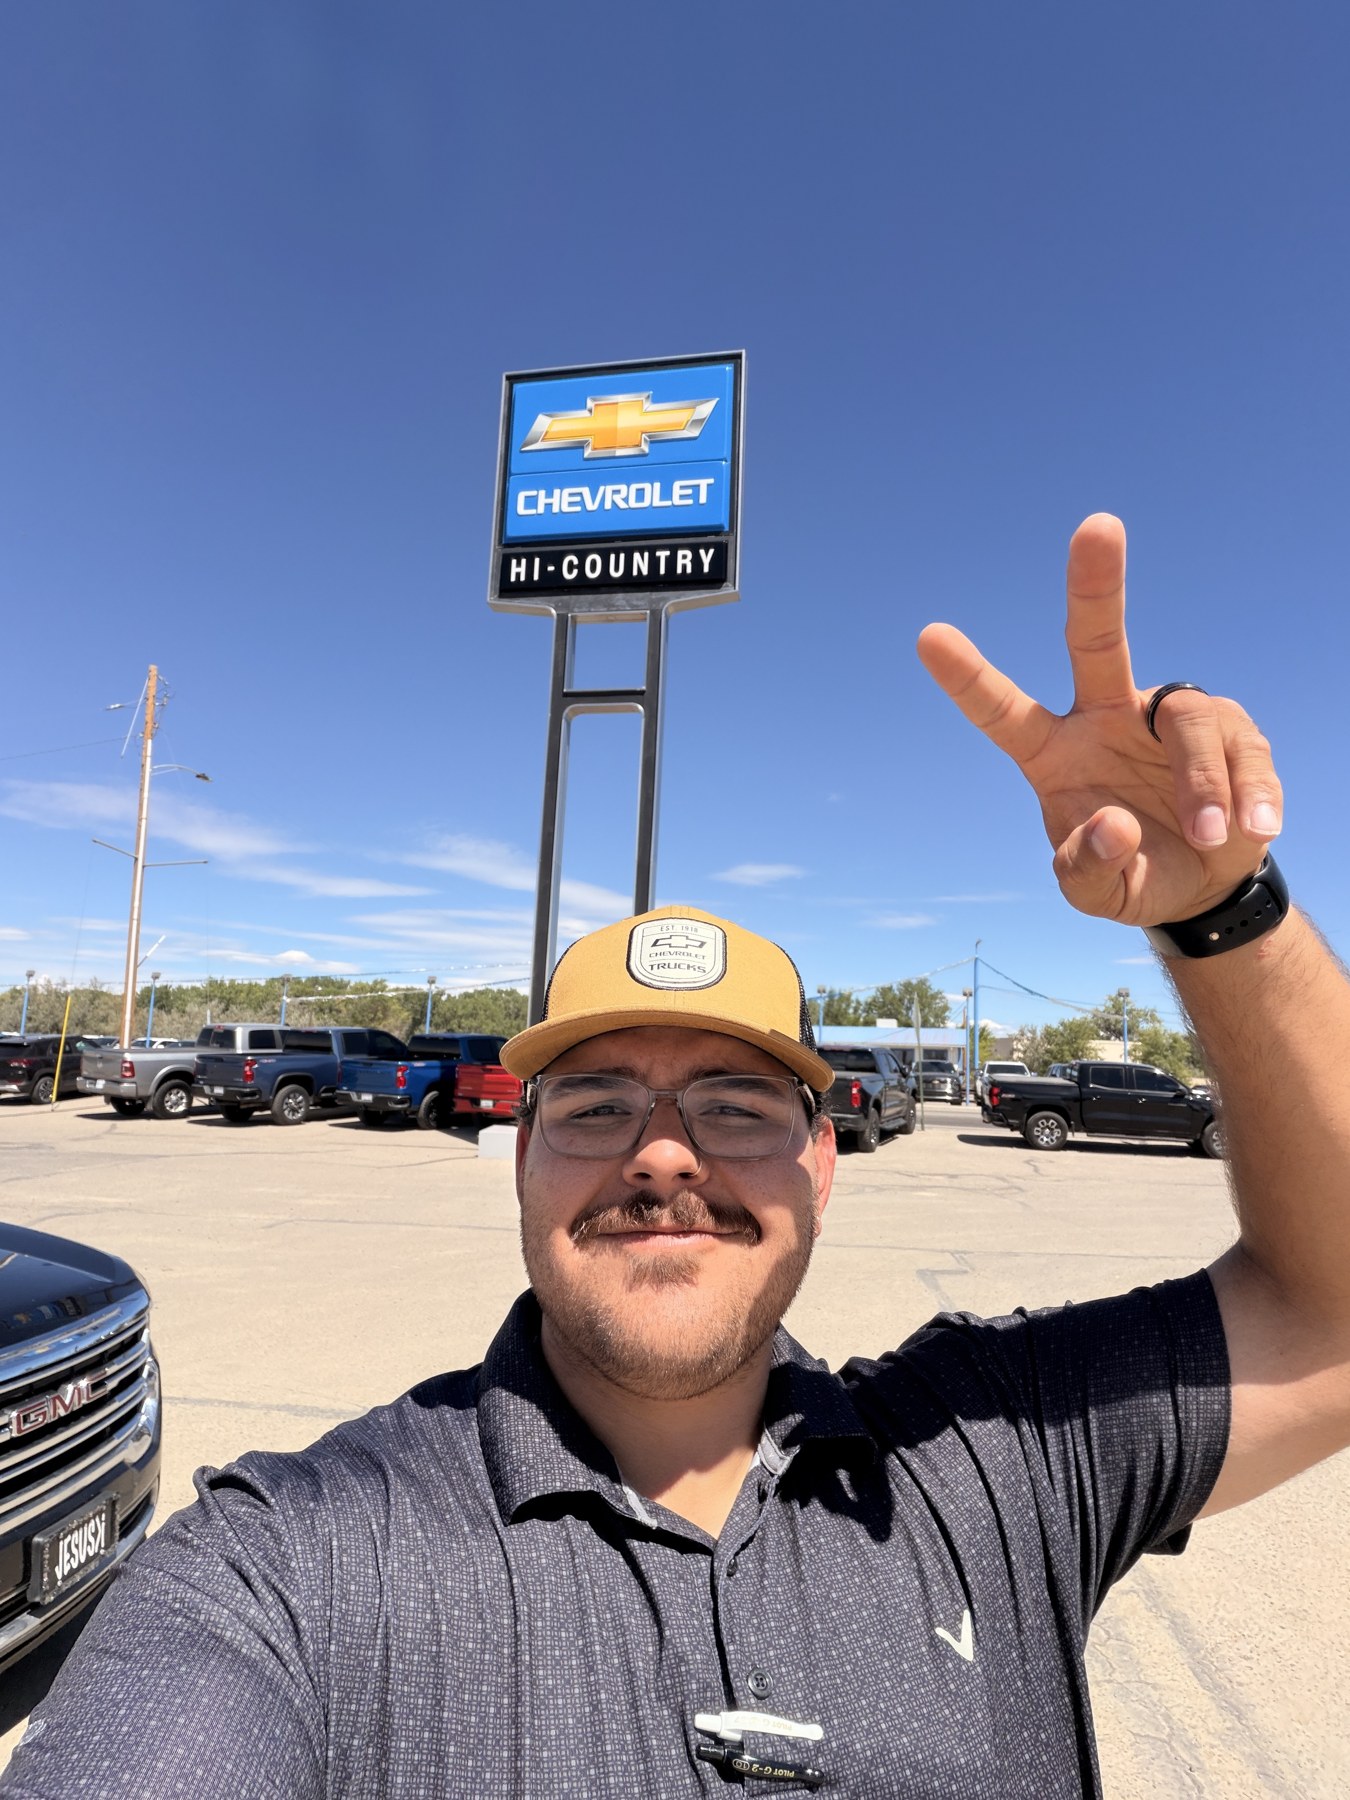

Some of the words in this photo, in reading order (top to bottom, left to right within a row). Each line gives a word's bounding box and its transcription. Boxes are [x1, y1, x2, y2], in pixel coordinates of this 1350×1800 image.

[517, 478, 714, 516] CHEVROLET
[510, 548, 715, 582] HI-COUNTRY
[649, 951, 706, 960] CHEVROLET
[649, 962, 706, 974] TRUCKS
[11, 1368, 109, 1437] GMC
[752, 1763, 772, 1775] G-2
[773, 1768, 795, 1777] PILOT
